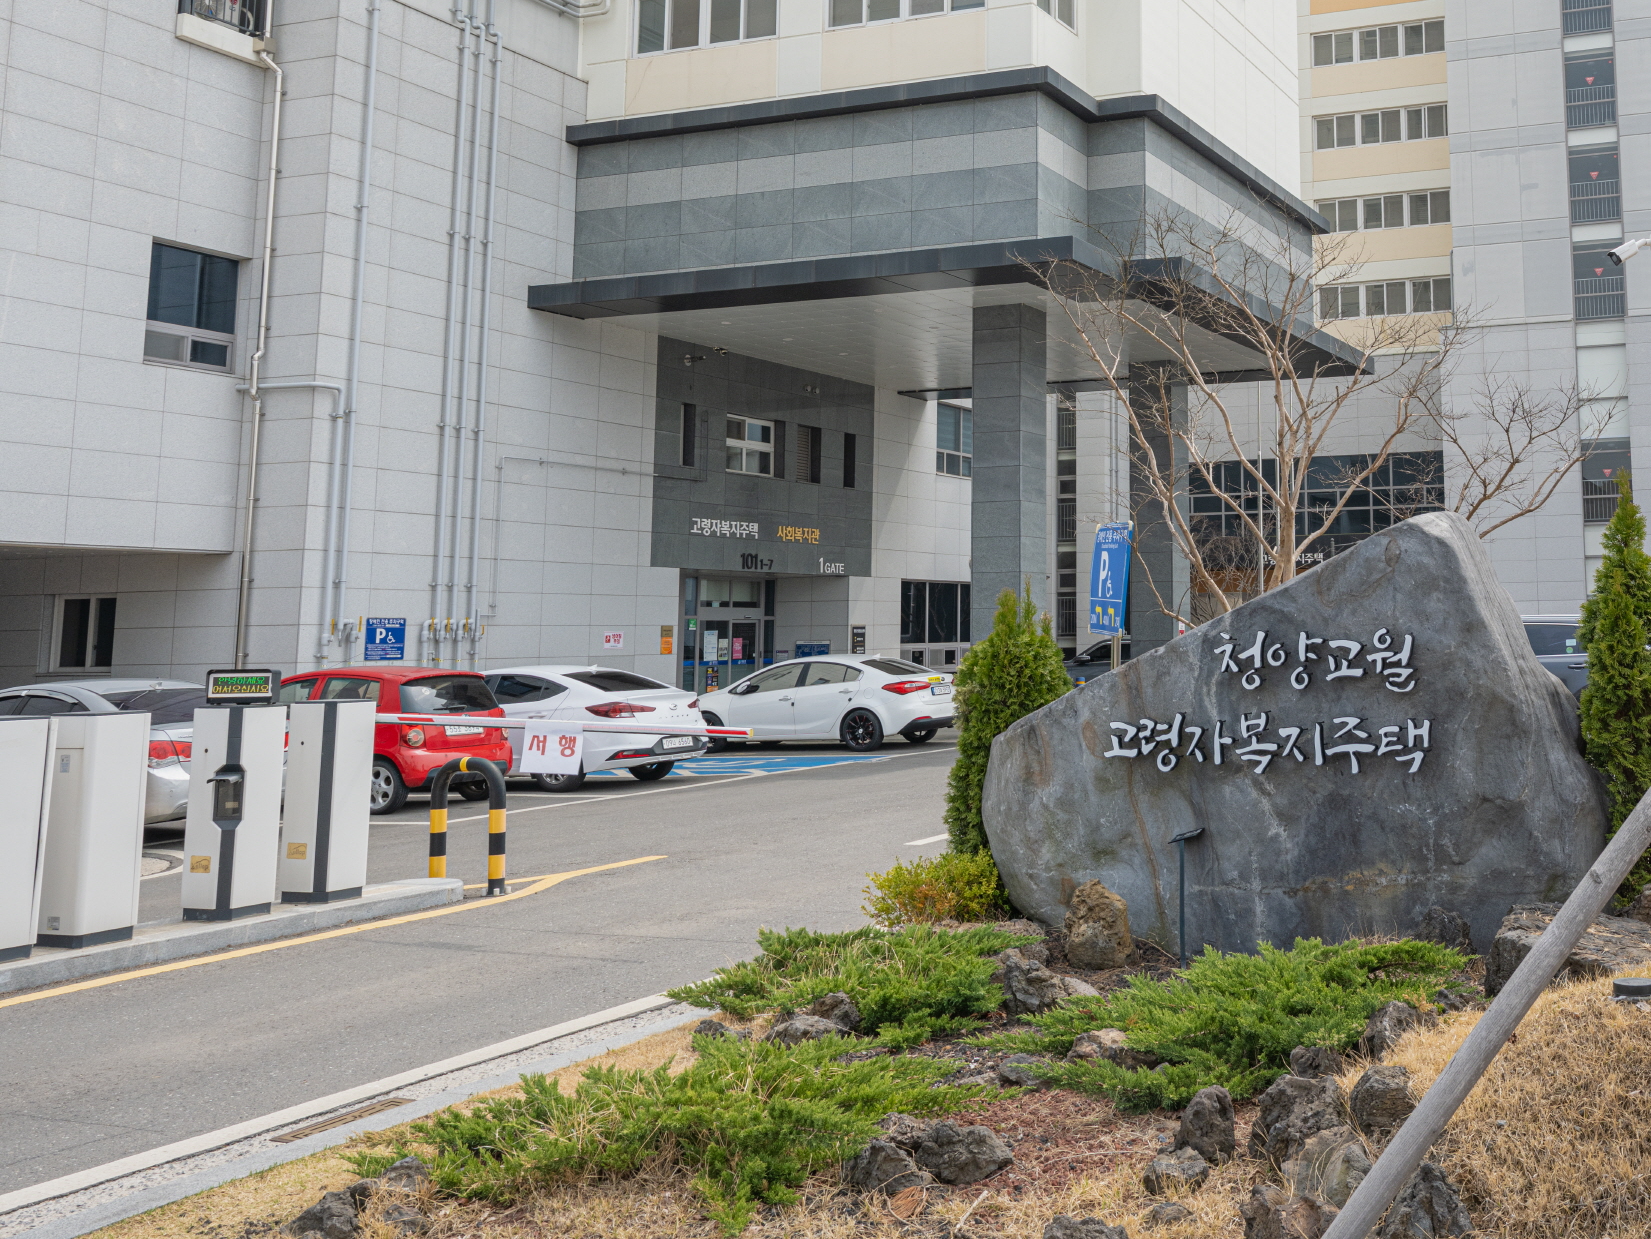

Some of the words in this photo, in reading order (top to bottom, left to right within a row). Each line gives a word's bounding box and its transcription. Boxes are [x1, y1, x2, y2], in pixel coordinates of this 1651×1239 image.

[690, 517, 759, 539] 고령자복지주택
[776, 525, 821, 544] 사회복지관
[740, 552, 758, 570] 101
[824, 563, 845, 574] GATE
[1098, 550, 1109, 598] P
[375, 628, 386, 644] P
[217, 676, 266, 685] 안녕하세요
[528, 734, 548, 756] 서
[558, 734, 577, 758] 행
[1103, 711, 1431, 775] 고령자복지주택
